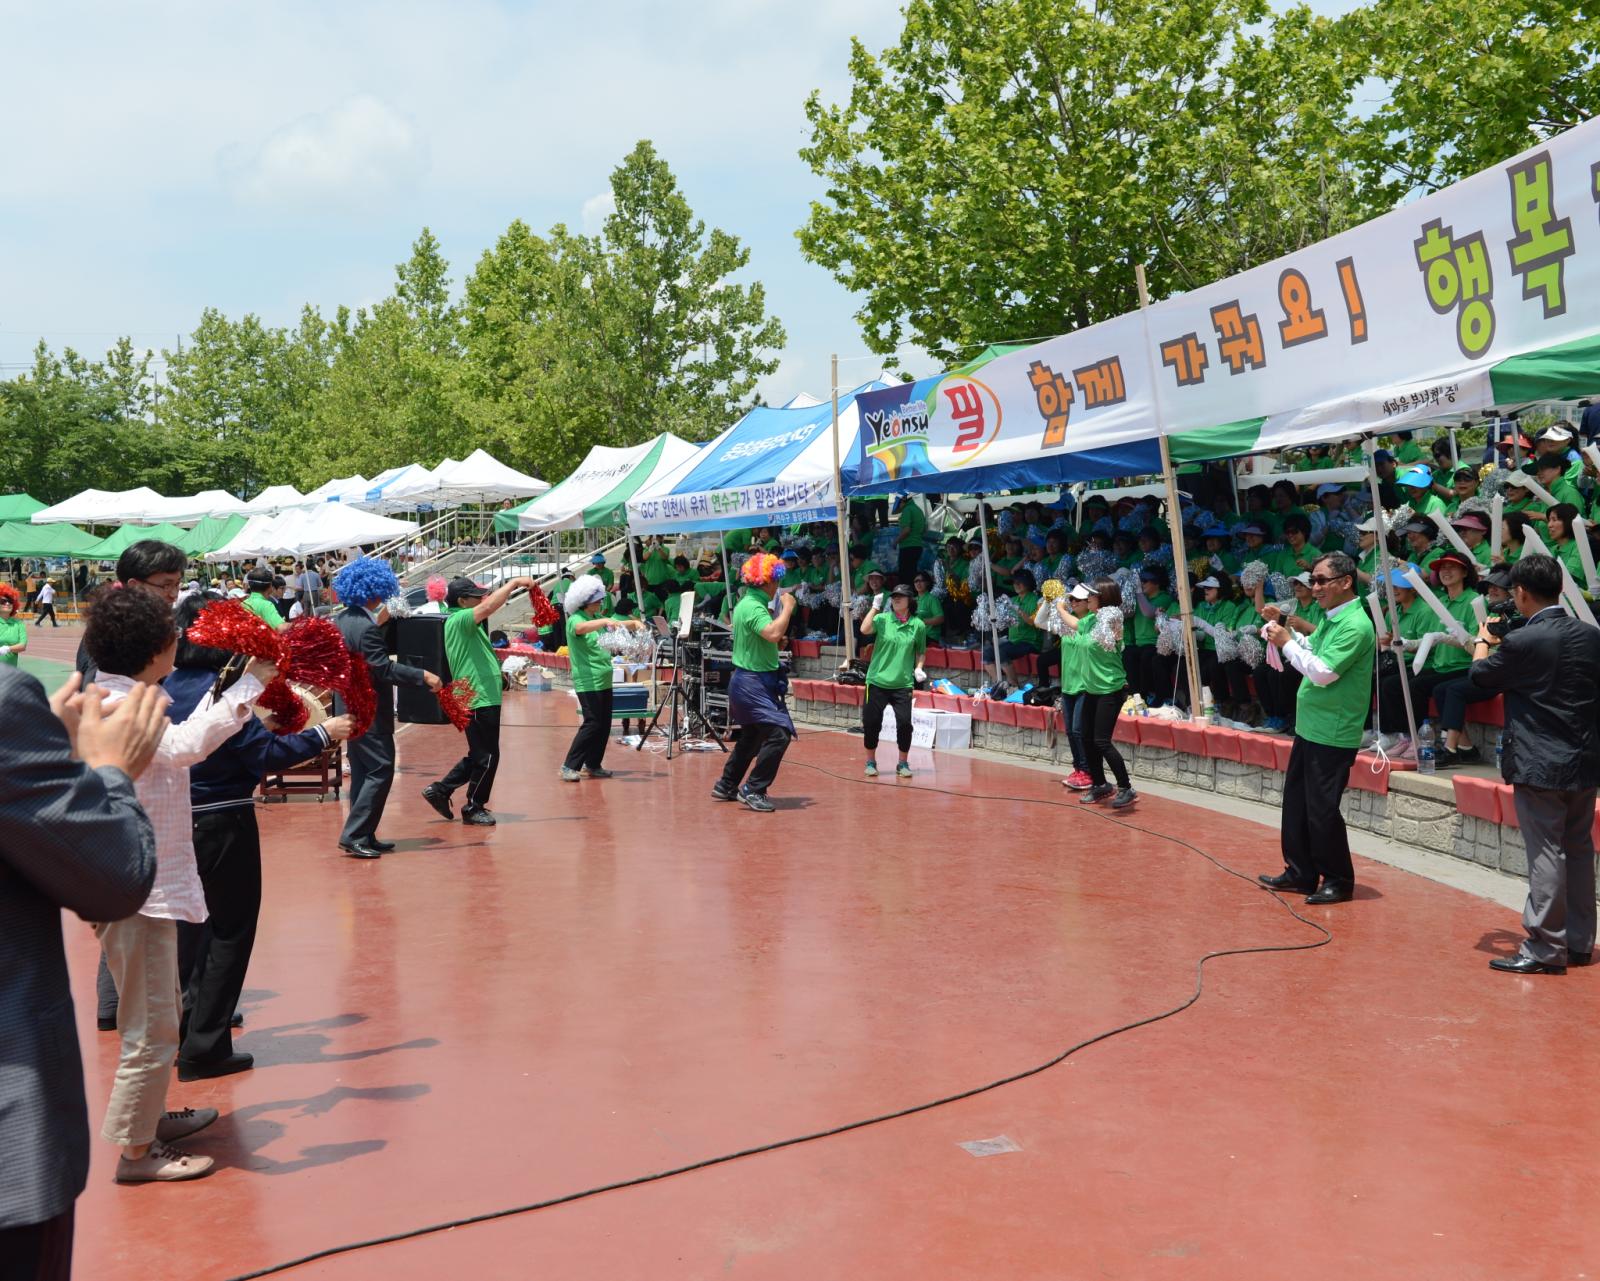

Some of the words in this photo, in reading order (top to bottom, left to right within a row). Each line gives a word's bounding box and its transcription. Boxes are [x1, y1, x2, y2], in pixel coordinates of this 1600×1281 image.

[1027, 355, 1126, 450] 함께
[1160, 256, 1368, 387] 가꿔요!
[1382, 396, 1410, 416] 새마을
[866, 411, 929, 447] Yeonsu
[641, 502, 659, 519] GCF
[663, 496, 688, 518] 인천시
[690, 495, 708, 516] 유치
[711, 489, 750, 514] 연수구가
[754, 482, 808, 509] 앞장섭니다
